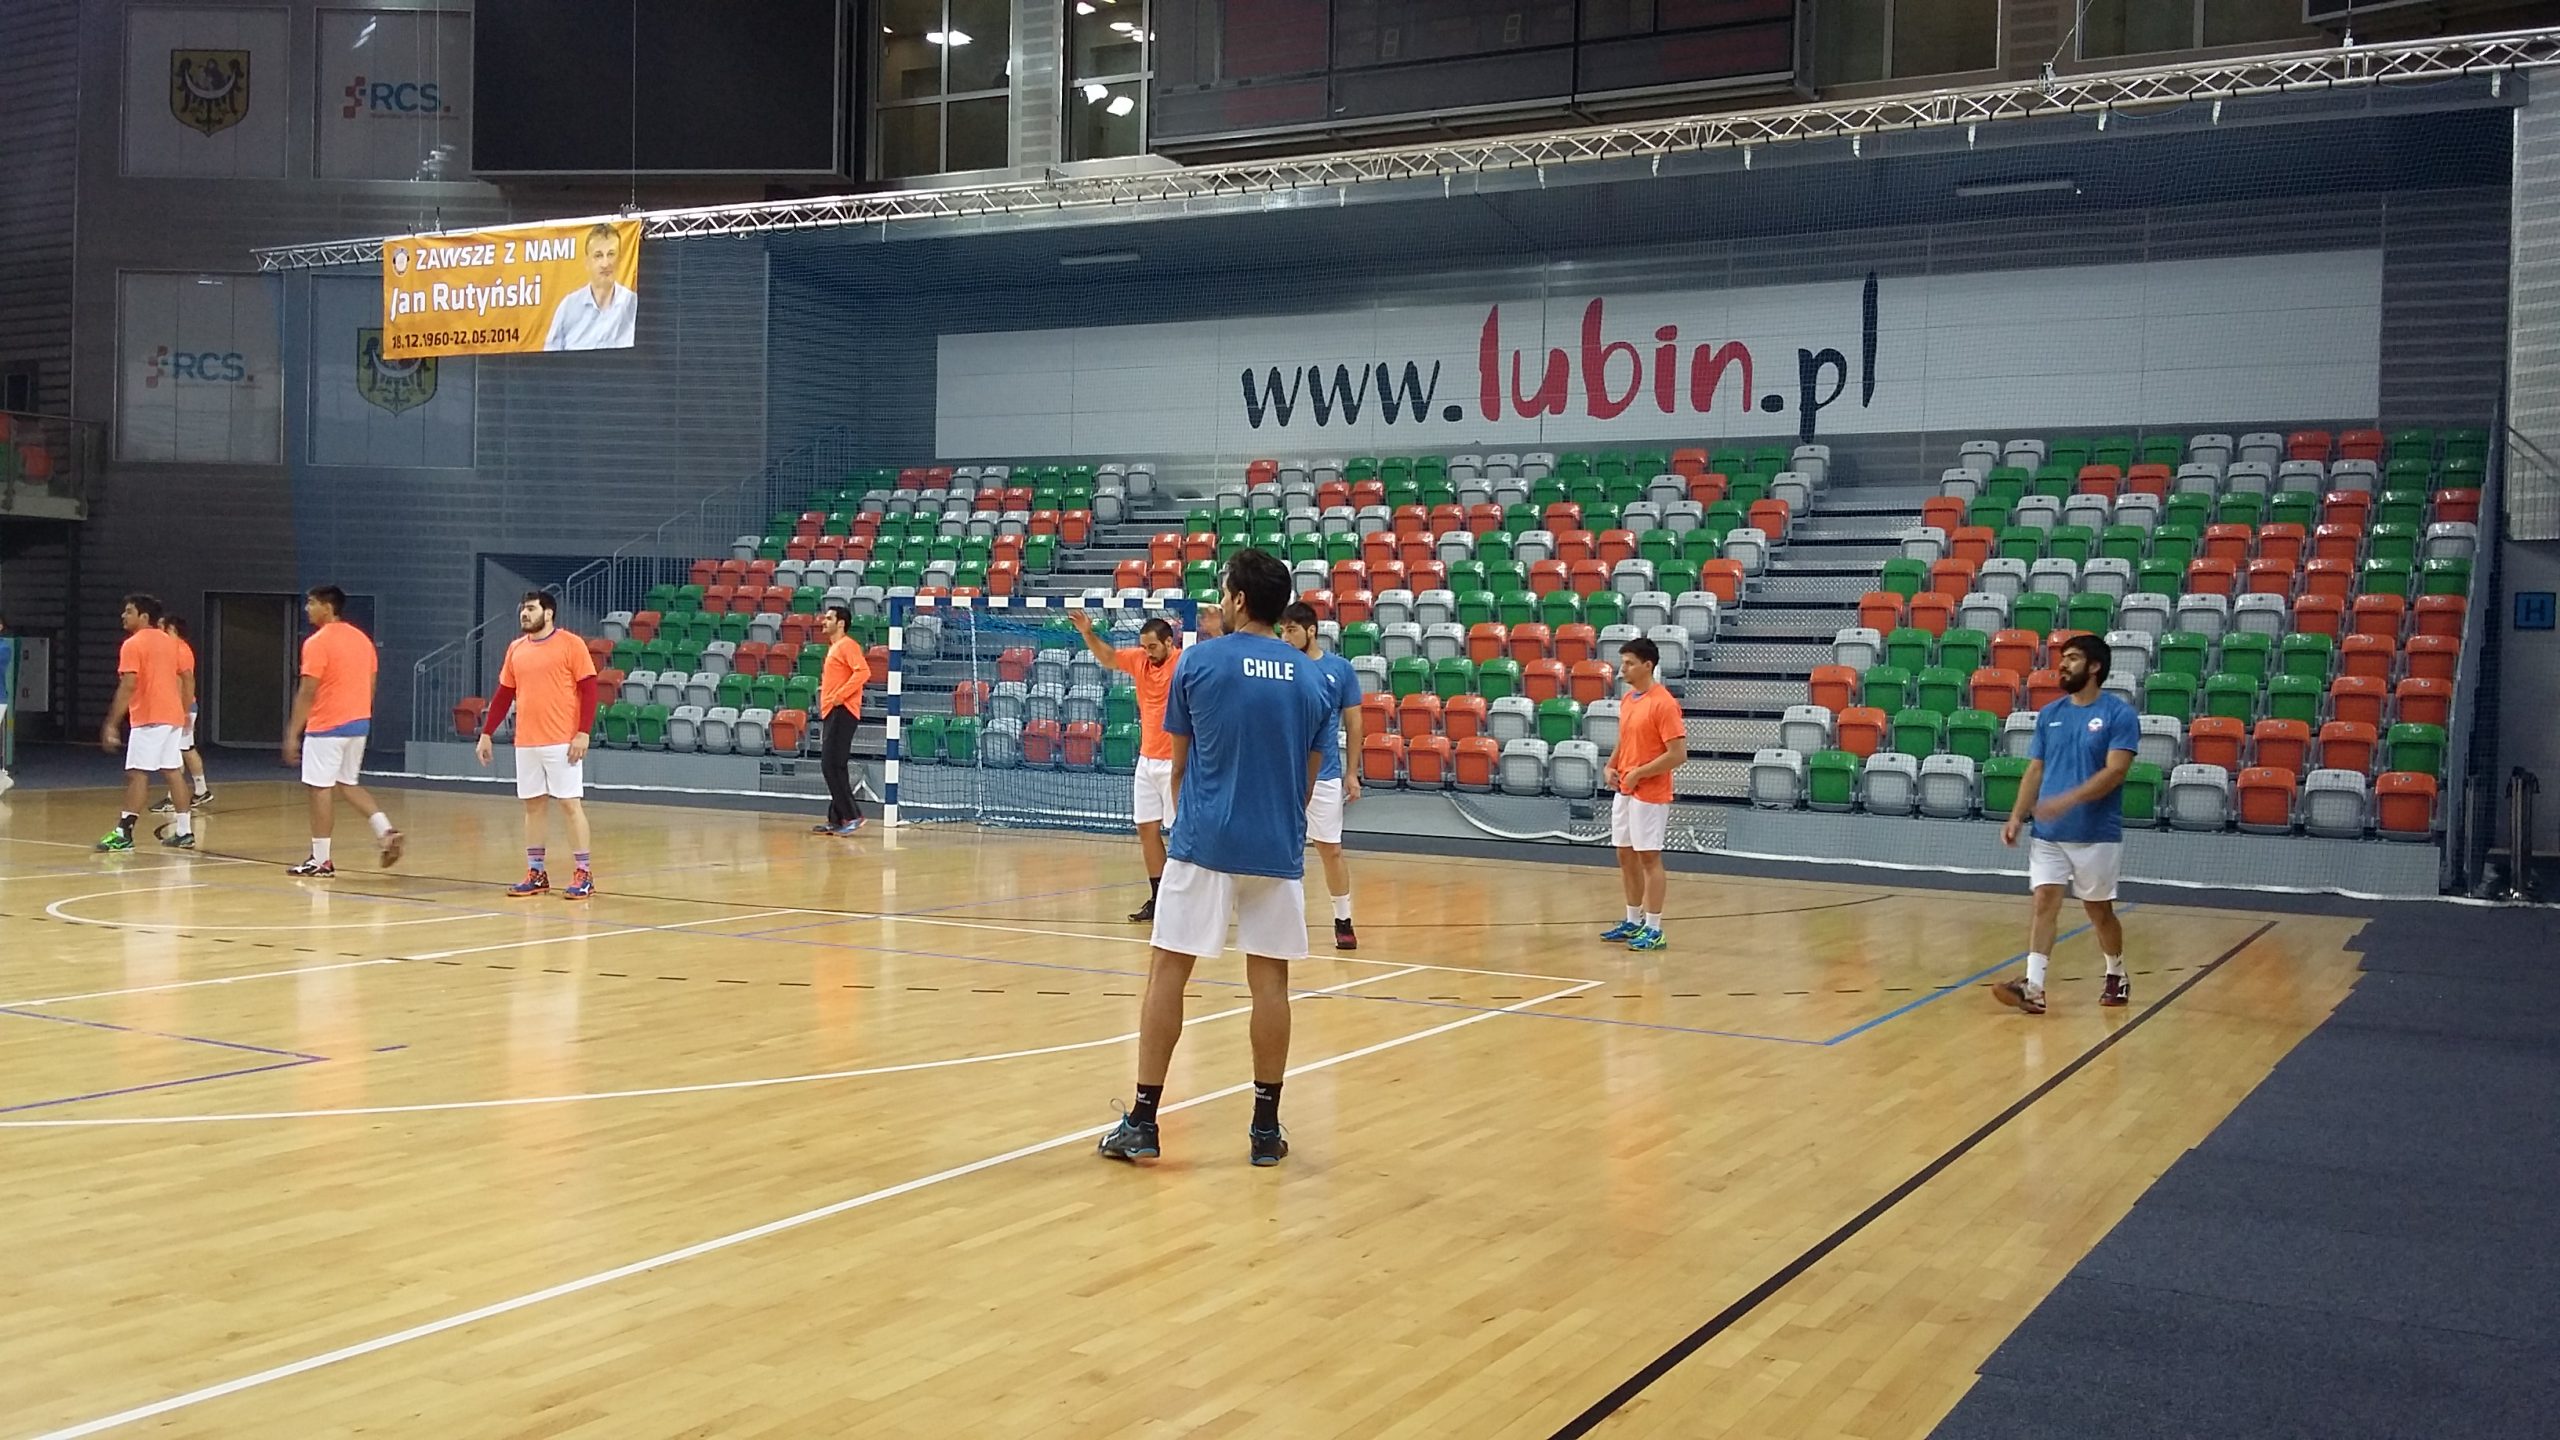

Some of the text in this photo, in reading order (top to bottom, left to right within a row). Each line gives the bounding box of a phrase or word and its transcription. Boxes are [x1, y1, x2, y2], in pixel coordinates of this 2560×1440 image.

[415, 237, 576, 271] ZAWSZE Z NAMI
[390, 274, 541, 322] Jan Rutyński
[1242, 271, 1878, 442] www.lubin.pl
[2524, 598, 2546, 622] H
[1243, 657, 1294, 682] CHILE
